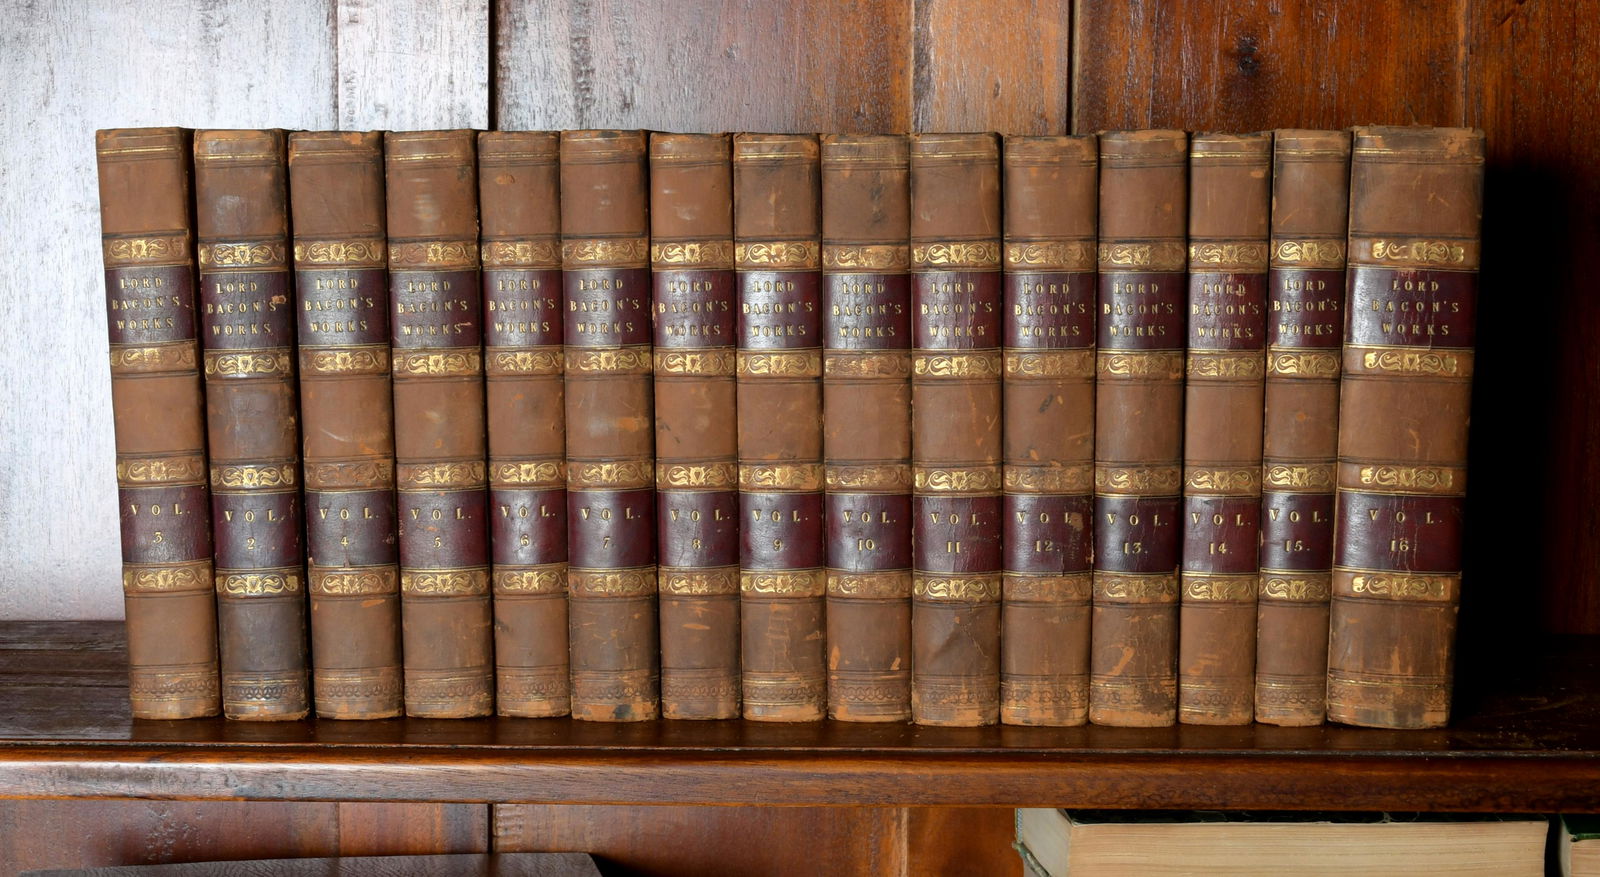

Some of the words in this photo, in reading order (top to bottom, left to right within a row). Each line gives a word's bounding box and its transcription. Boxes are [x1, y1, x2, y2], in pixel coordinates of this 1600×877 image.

[120, 277, 163, 289] LORD
[215, 281, 258, 294] LORD
[316, 278, 359, 291] LORD
[408, 280, 451, 293] LORD
[497, 278, 541, 291] LORD
[579, 279, 624, 291] LORD
[669, 280, 713, 293] LORD
[752, 280, 795, 293] LORD
[842, 281, 885, 295] LORD
[930, 281, 976, 295] LORD
[1023, 282, 1070, 295] LORD
[1114, 282, 1160, 294] LORD
[1203, 283, 1247, 296] LORD
[1284, 279, 1327, 292] LORD
[1393, 279, 1440, 292] LORD
[112, 296, 180, 310] BACON'S
[206, 299, 278, 314] BACON'S
[304, 297, 375, 311] BACON'S
[397, 299, 468, 314] BACON'S
[489, 297, 556, 312] BACON'S
[569, 297, 641, 312] BACON'S
[658, 299, 729, 314] BACON'S
[742, 300, 814, 315] BACON'S
[832, 302, 902, 317] BACON'S
[920, 300, 993, 316] BACON'S
[1014, 301, 1086, 316] BACON'S
[1103, 302, 1175, 316] BACON'S
[1191, 302, 1261, 316] BACON'S
[1273, 298, 1340, 313] BACON'S
[1371, 299, 1460, 313] BACON'S
[116, 317, 174, 331] WORKS
[212, 322, 271, 335] WORKS
[310, 320, 368, 332] WORKS
[402, 321, 462, 335] WORKS
[494, 321, 551, 333] WORKS
[577, 321, 634, 334] WORKS
[665, 323, 721, 336] WORKS
[750, 323, 807, 337] WORKS
[1279, 324, 1334, 337] WORKS
[1382, 322, 1449, 336] WORKS
[839, 326, 896, 338] WORKS
[929, 325, 986, 338] WORKS
[1020, 325, 1081, 338] WORKS
[1110, 325, 1166, 337] WORKS
[1197, 327, 1254, 340] WORKS
[152, 531, 164, 544] 3
[247, 537, 256, 550] 2
[340, 536, 350, 548] 4
[433, 536, 442, 549] 5
[519, 533, 531, 547] 6
[1390, 538, 1410, 552] 16
